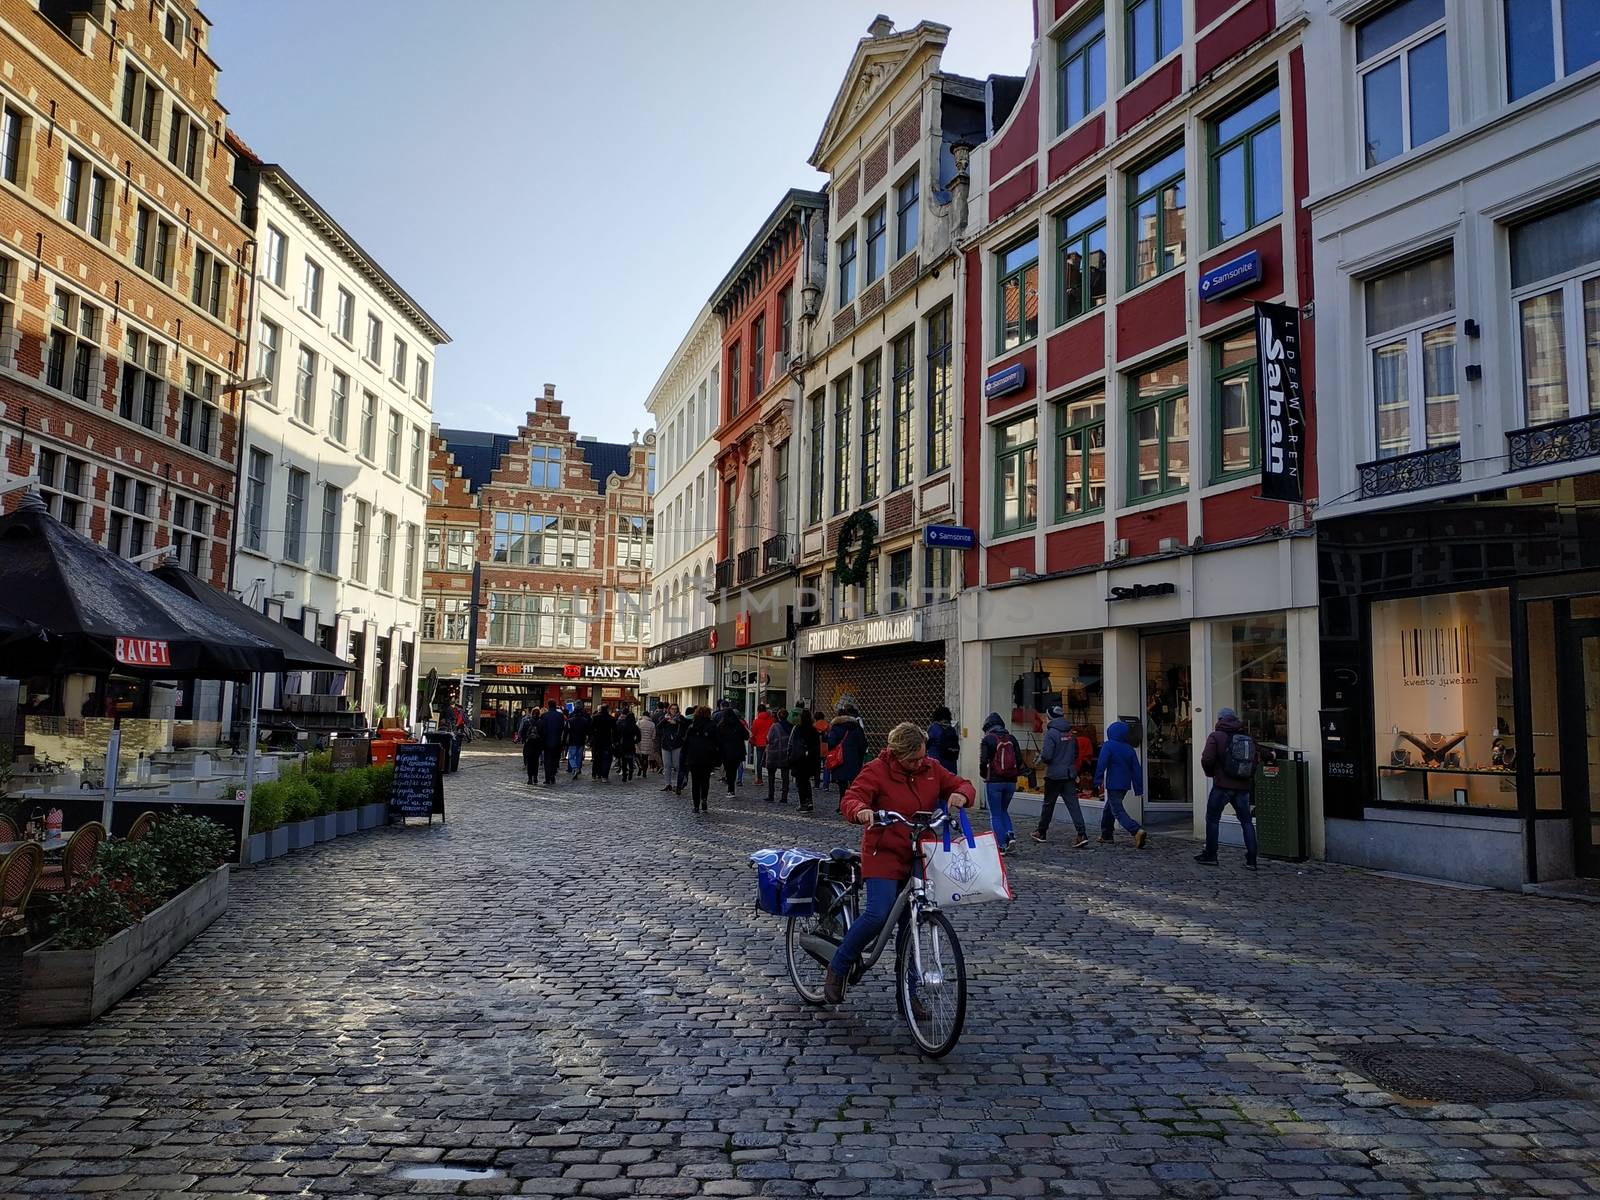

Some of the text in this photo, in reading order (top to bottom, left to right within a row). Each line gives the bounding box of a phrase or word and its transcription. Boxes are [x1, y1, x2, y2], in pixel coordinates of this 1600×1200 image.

[1212, 262, 1253, 286] Samsonite
[1265, 317, 1285, 474] Sahan
[1285, 321, 1301, 477] LEDERWAREN
[938, 532, 972, 542] Samsonite
[808, 615, 913, 652] FRITUUR Frans HOOIAARD
[115, 638, 167, 663] BAVET
[585, 666, 621, 678] HANS
[1403, 676, 1478, 687] kwesto juwelen
